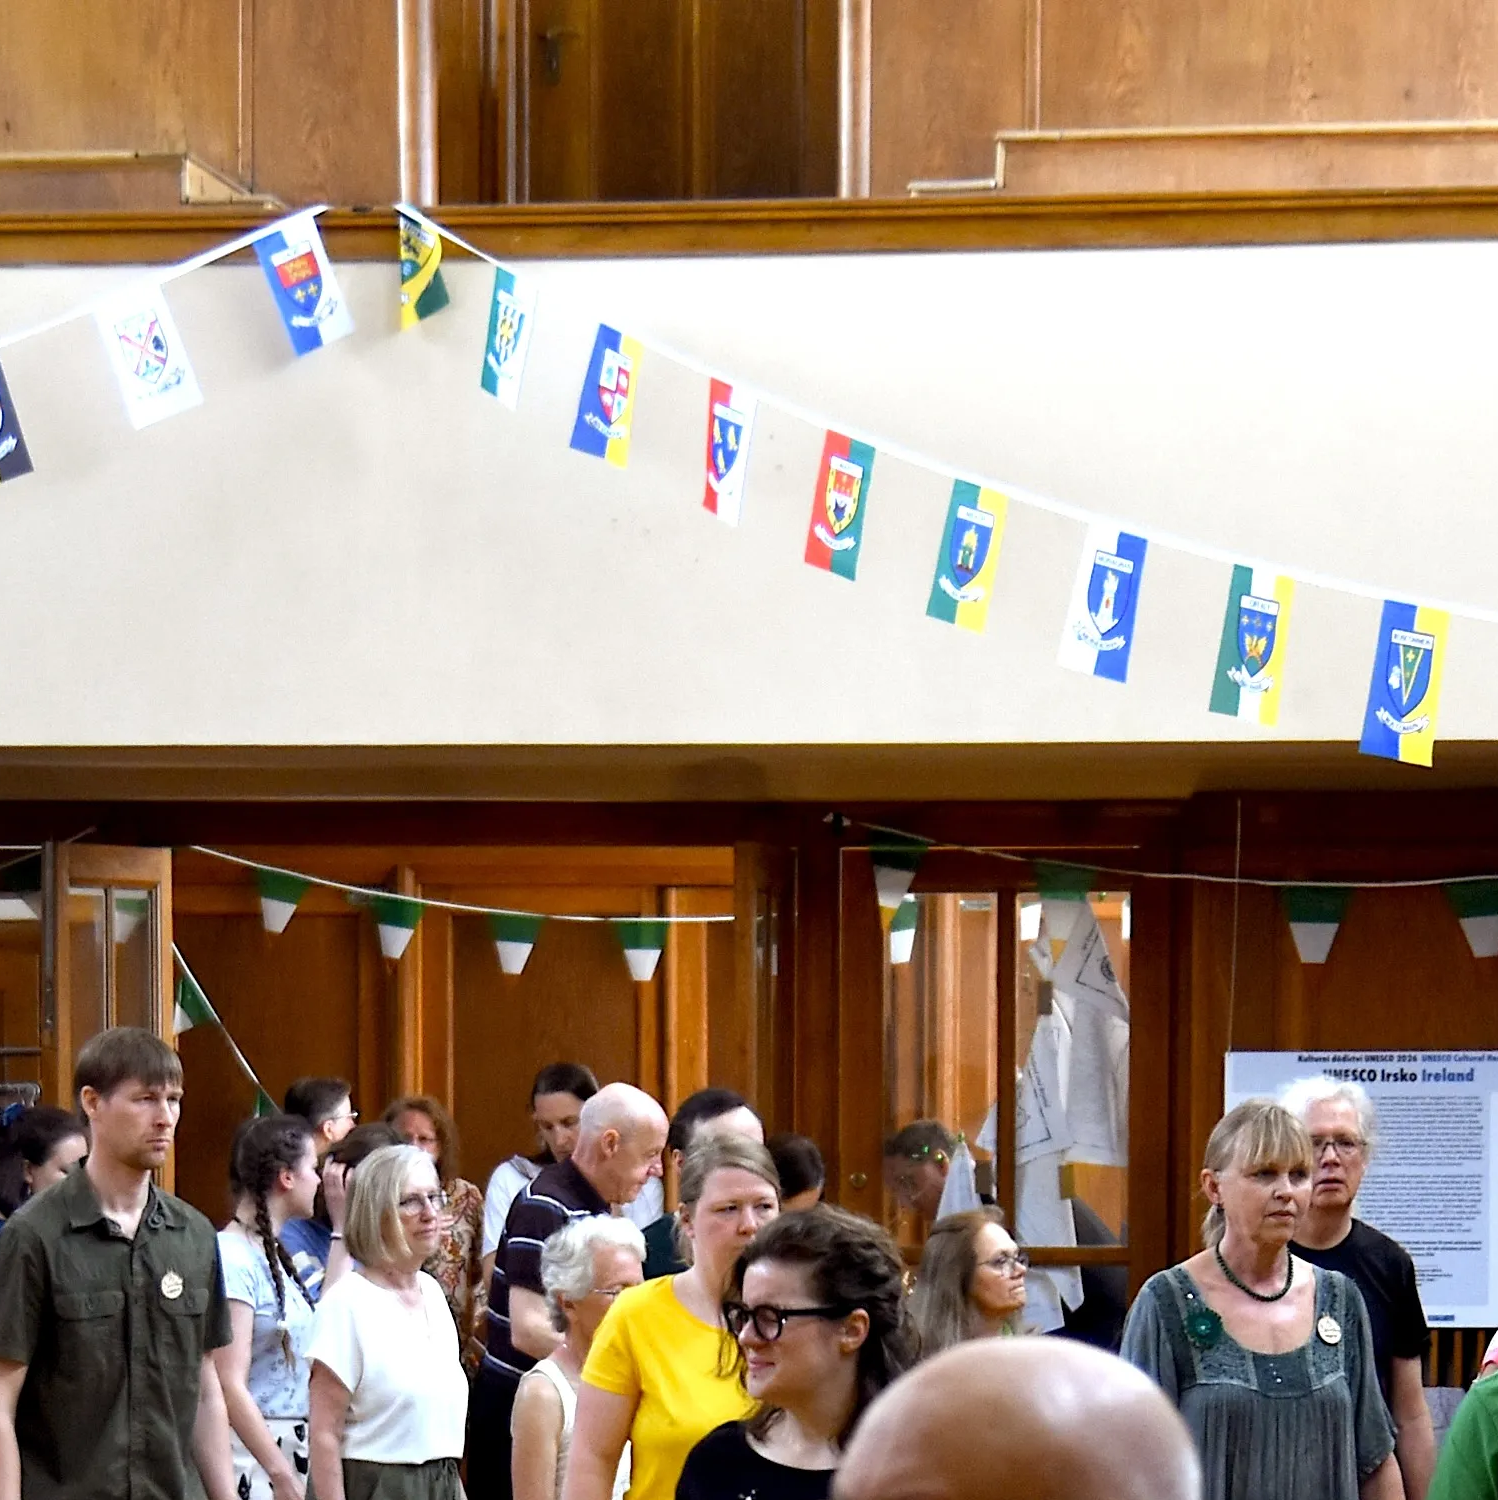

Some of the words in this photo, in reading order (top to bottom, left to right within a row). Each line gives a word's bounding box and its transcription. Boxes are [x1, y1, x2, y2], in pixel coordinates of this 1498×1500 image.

[1364, 1054, 1395, 1062] UNESCO
[1421, 1054, 1452, 1062] UNESCO
[1454, 1054, 1485, 1062] Cultural
[1381, 1067, 1418, 1082] Irsko
[1421, 1068, 1475, 1082] Ireland
